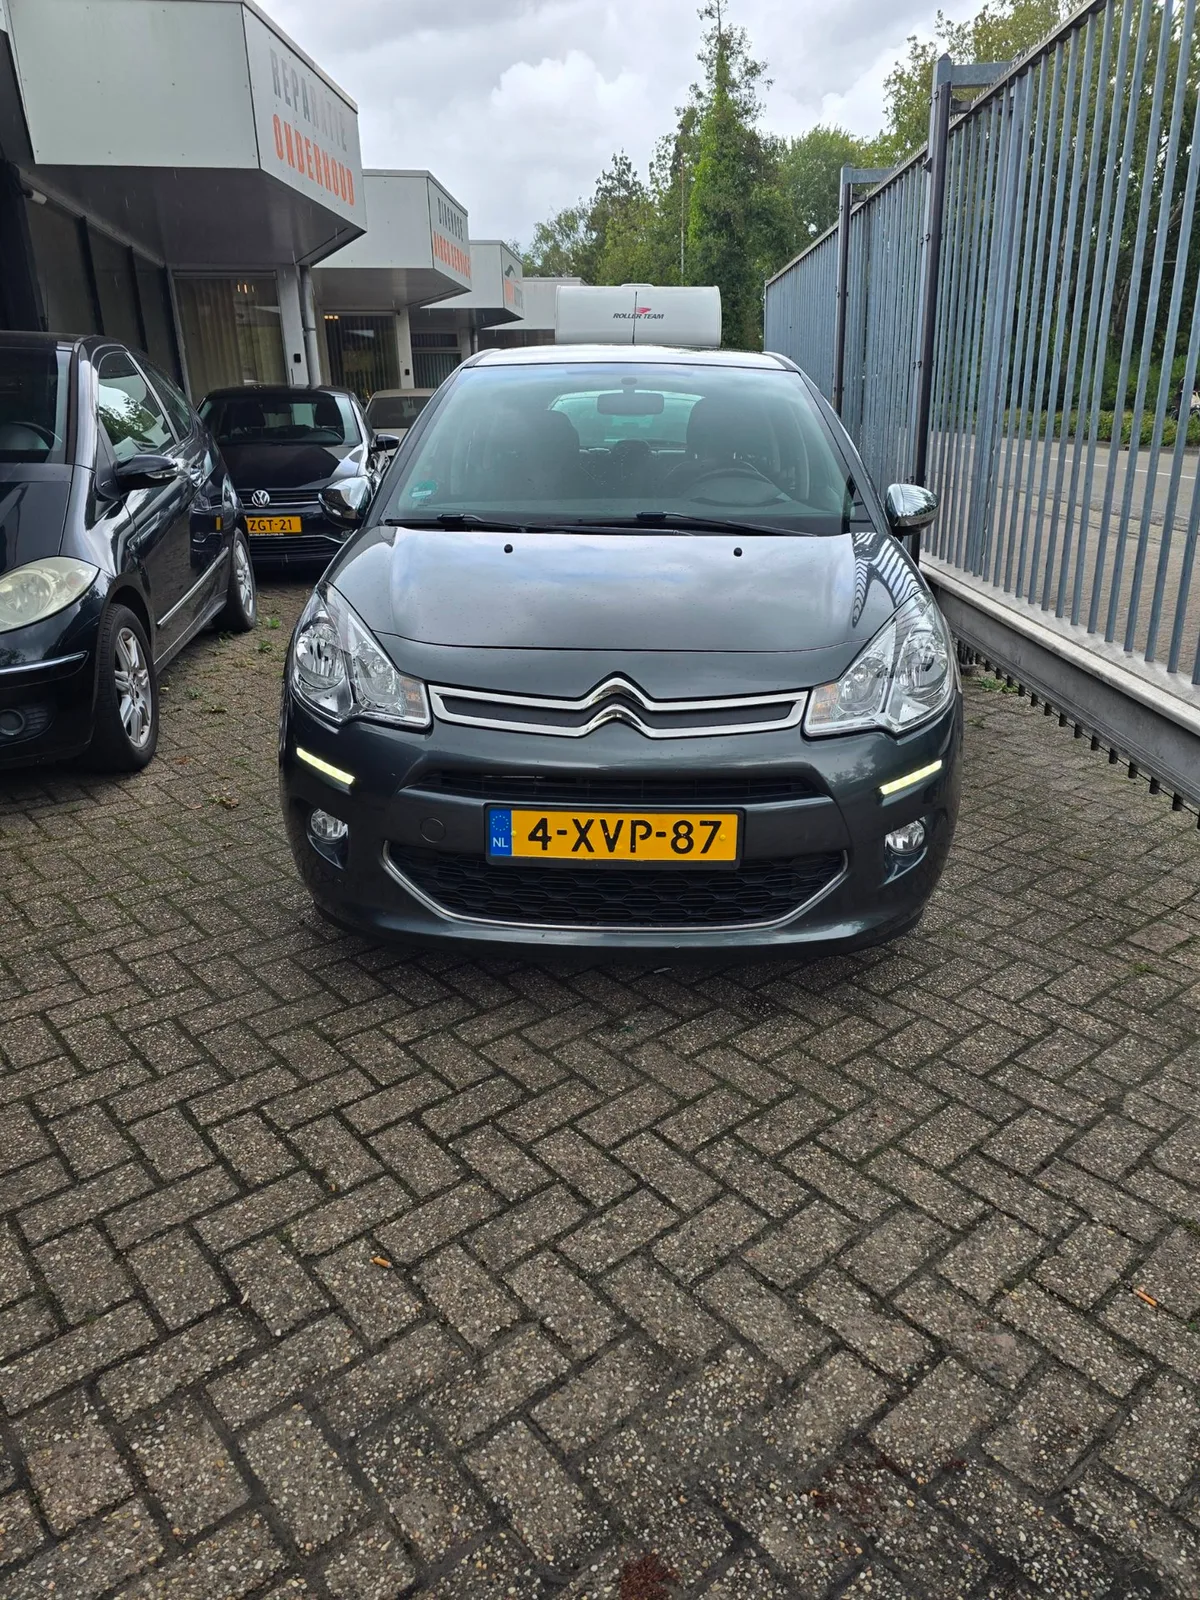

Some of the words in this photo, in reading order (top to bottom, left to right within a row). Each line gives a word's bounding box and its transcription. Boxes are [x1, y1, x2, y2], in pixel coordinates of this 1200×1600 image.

[272, 113, 355, 206] ONDERHOUD
[492, 836, 509, 848] NL
[527, 817, 723, 855] 4-XVP-87
